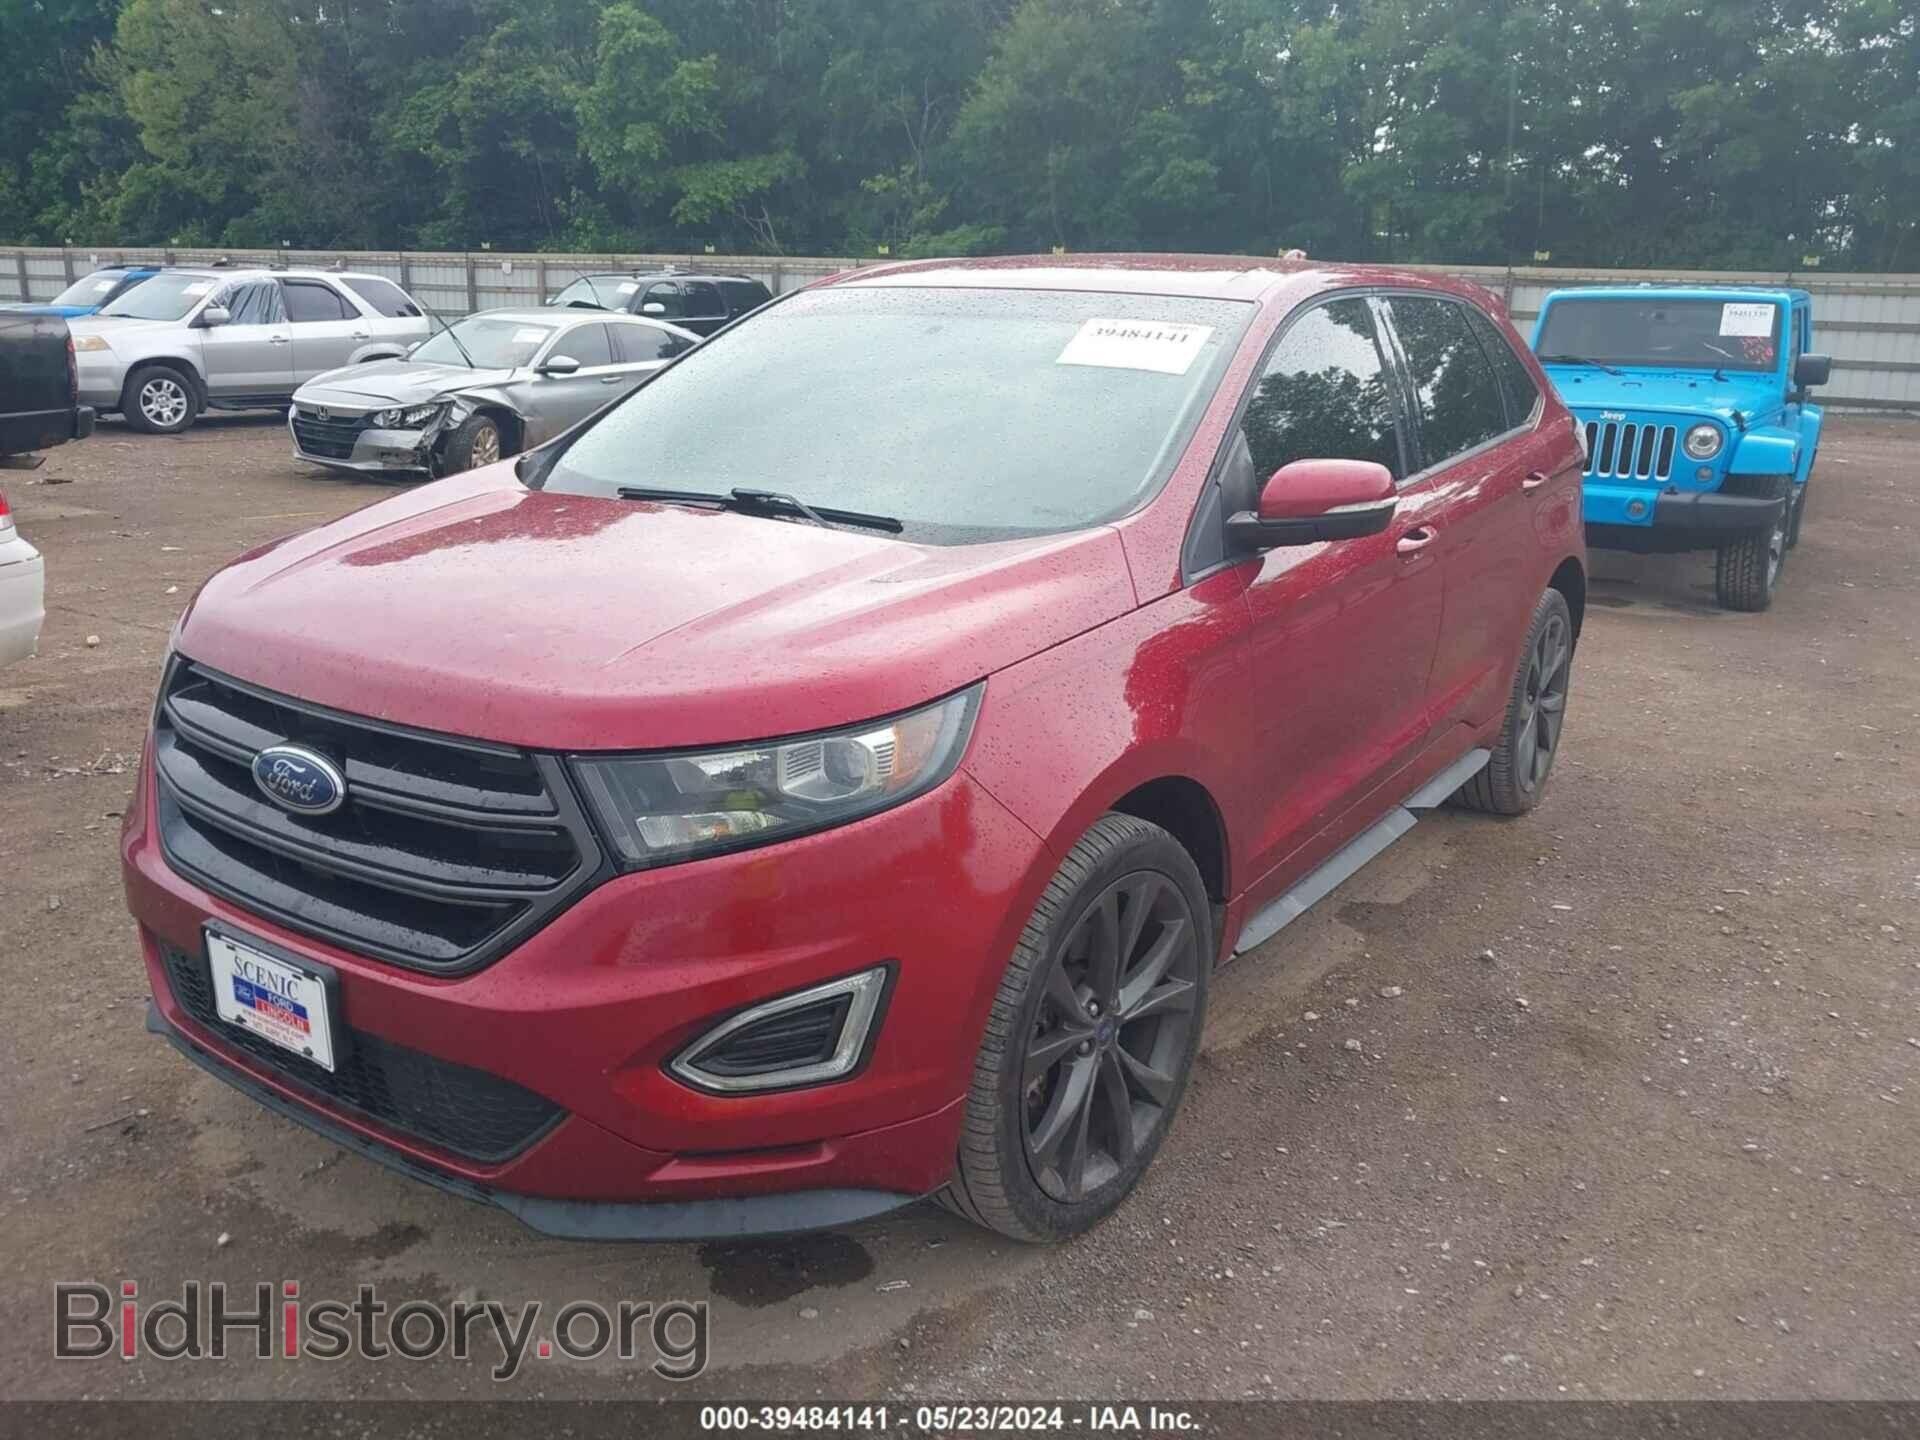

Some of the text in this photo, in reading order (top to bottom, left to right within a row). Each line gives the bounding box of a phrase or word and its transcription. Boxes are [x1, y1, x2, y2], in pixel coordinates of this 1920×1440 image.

[1600, 410, 1626, 421] Jeep
[267, 759, 317, 801] Ford
[234, 955, 299, 1001] SCENIC
[267, 992, 294, 1012] FORD
